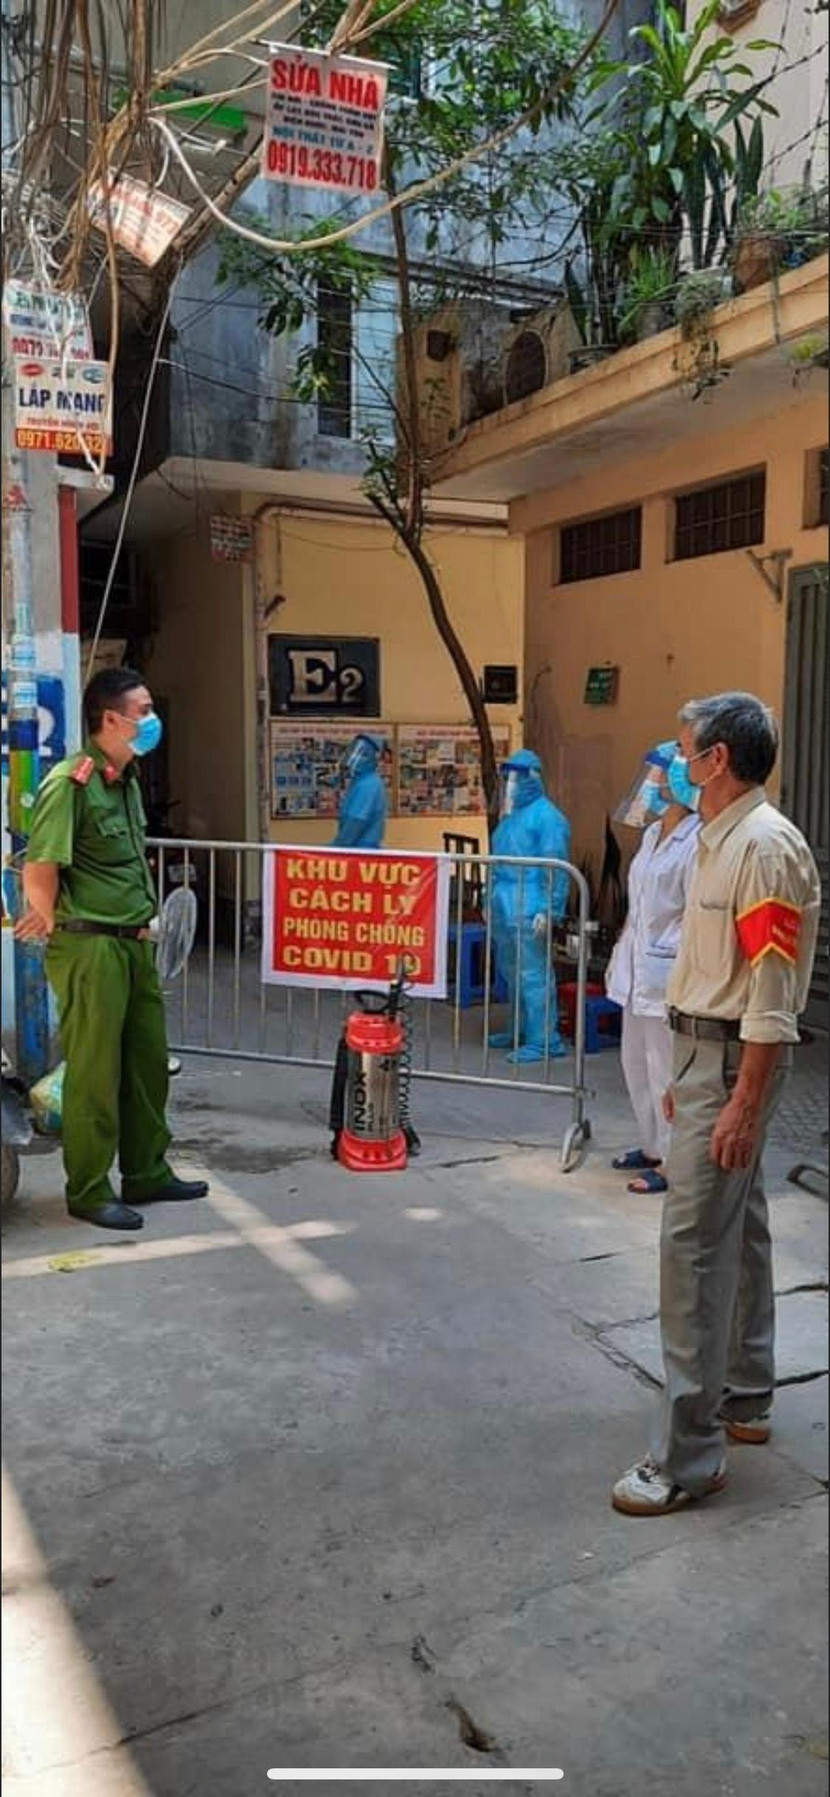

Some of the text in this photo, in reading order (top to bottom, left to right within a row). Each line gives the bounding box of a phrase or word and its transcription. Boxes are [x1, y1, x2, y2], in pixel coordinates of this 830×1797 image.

[272, 53, 321, 96] SỬA
[268, 139, 377, 190] 0919.333.718
[286, 858, 422, 890] KHU VỰC
[289, 885, 419, 916] CÁCH LY
[283, 914, 425, 946] PHÒNG CHỐNG
[282, 945, 373, 972] COVID
[355, 1071, 367, 1132] INOX
